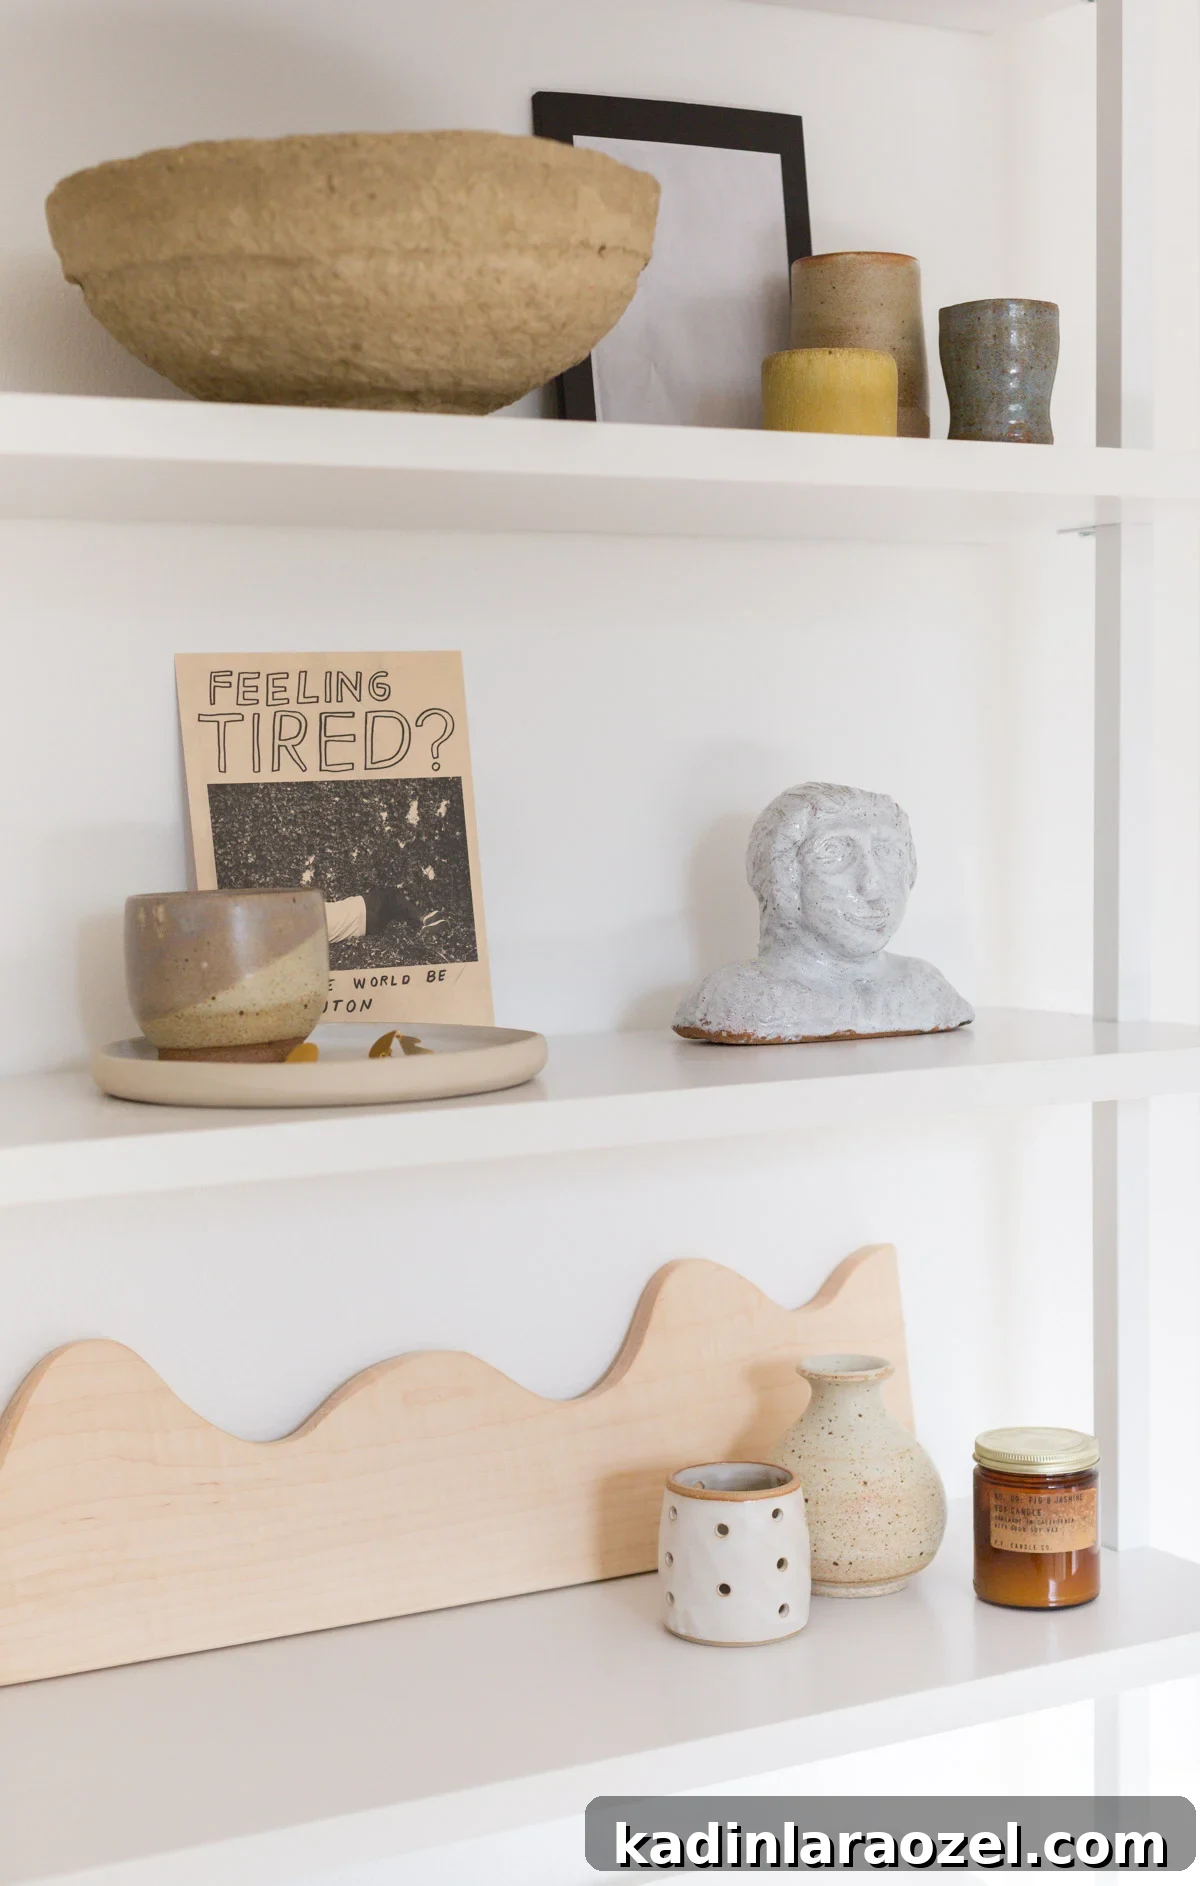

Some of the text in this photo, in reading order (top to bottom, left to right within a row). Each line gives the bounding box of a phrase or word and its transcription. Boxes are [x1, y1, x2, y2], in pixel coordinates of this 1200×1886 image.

[209, 670, 391, 706] FEELING
[198, 708, 455, 773] TIRED?
[353, 974, 411, 990] WORLD
[426, 969, 447, 983] BE
[1029, 1496, 1043, 1504] FIG
[1054, 1493, 1084, 1504] JASMINE
[1010, 1506, 1042, 1517] CANDLE
[1010, 1542, 1037, 1551] CANDLE
